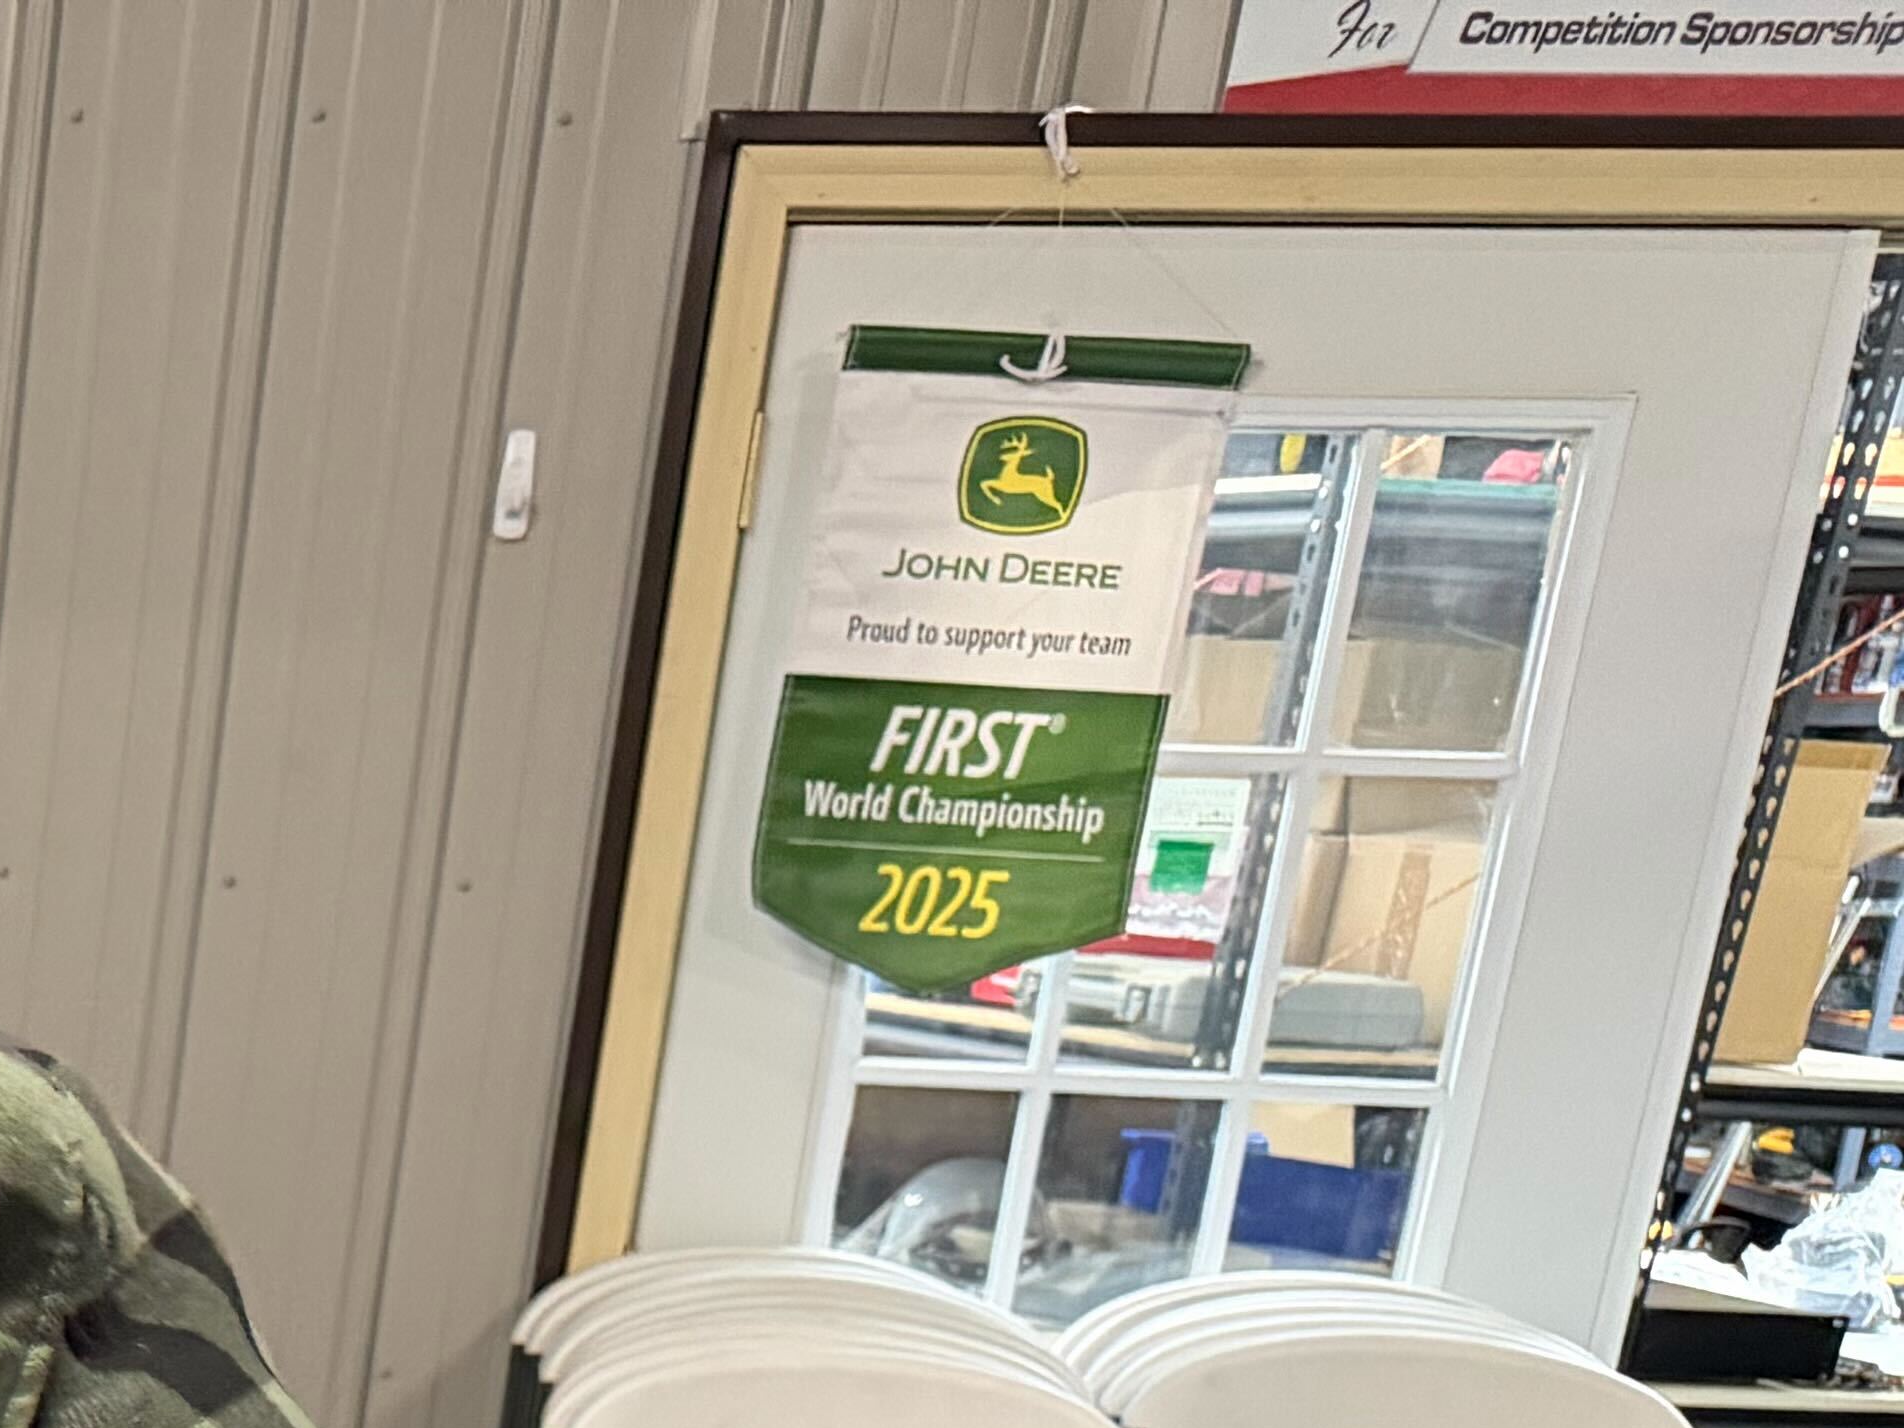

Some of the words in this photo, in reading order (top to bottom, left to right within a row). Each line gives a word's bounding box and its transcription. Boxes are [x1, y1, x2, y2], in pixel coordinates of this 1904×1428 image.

[1460, 11, 1677, 54] Competition
[1680, 11, 1904, 56] Sponsorship
[882, 548, 989, 583] JOHN
[998, 553, 1123, 590] DEERE
[847, 614, 911, 644] Proud
[916, 620, 938, 645] to
[943, 624, 1024, 656] support
[1027, 631, 1074, 659] your
[1078, 629, 1132, 657] team
[804, 779, 893, 823] World
[898, 784, 1106, 844] Championship
[859, 864, 1011, 939] 2025
